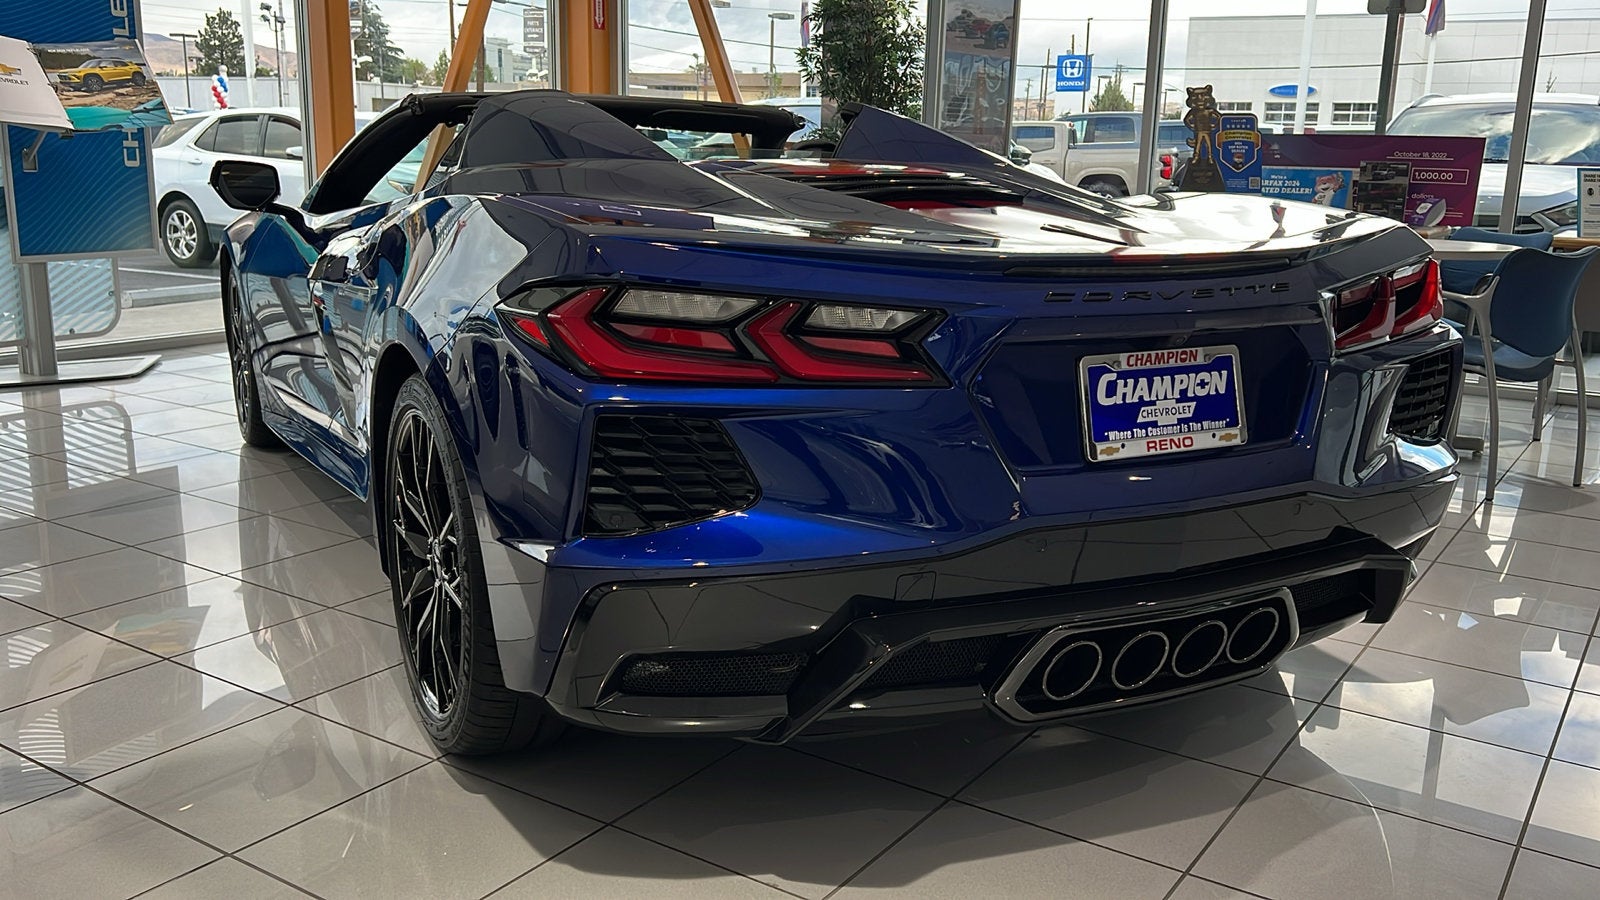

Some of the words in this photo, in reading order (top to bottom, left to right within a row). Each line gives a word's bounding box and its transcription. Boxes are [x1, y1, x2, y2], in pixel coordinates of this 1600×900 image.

[1044, 282, 1290, 302] CORVETTE
[1126, 350, 1198, 367] CHAMPION
[1097, 370, 1228, 406] CHAMPION
[1141, 405, 1192, 419] CHEVROLET
[1133, 428, 1145, 437] The
[1148, 425, 1180, 436] Customer
[1190, 422, 1201, 431] The
[1146, 436, 1194, 452] RENO
